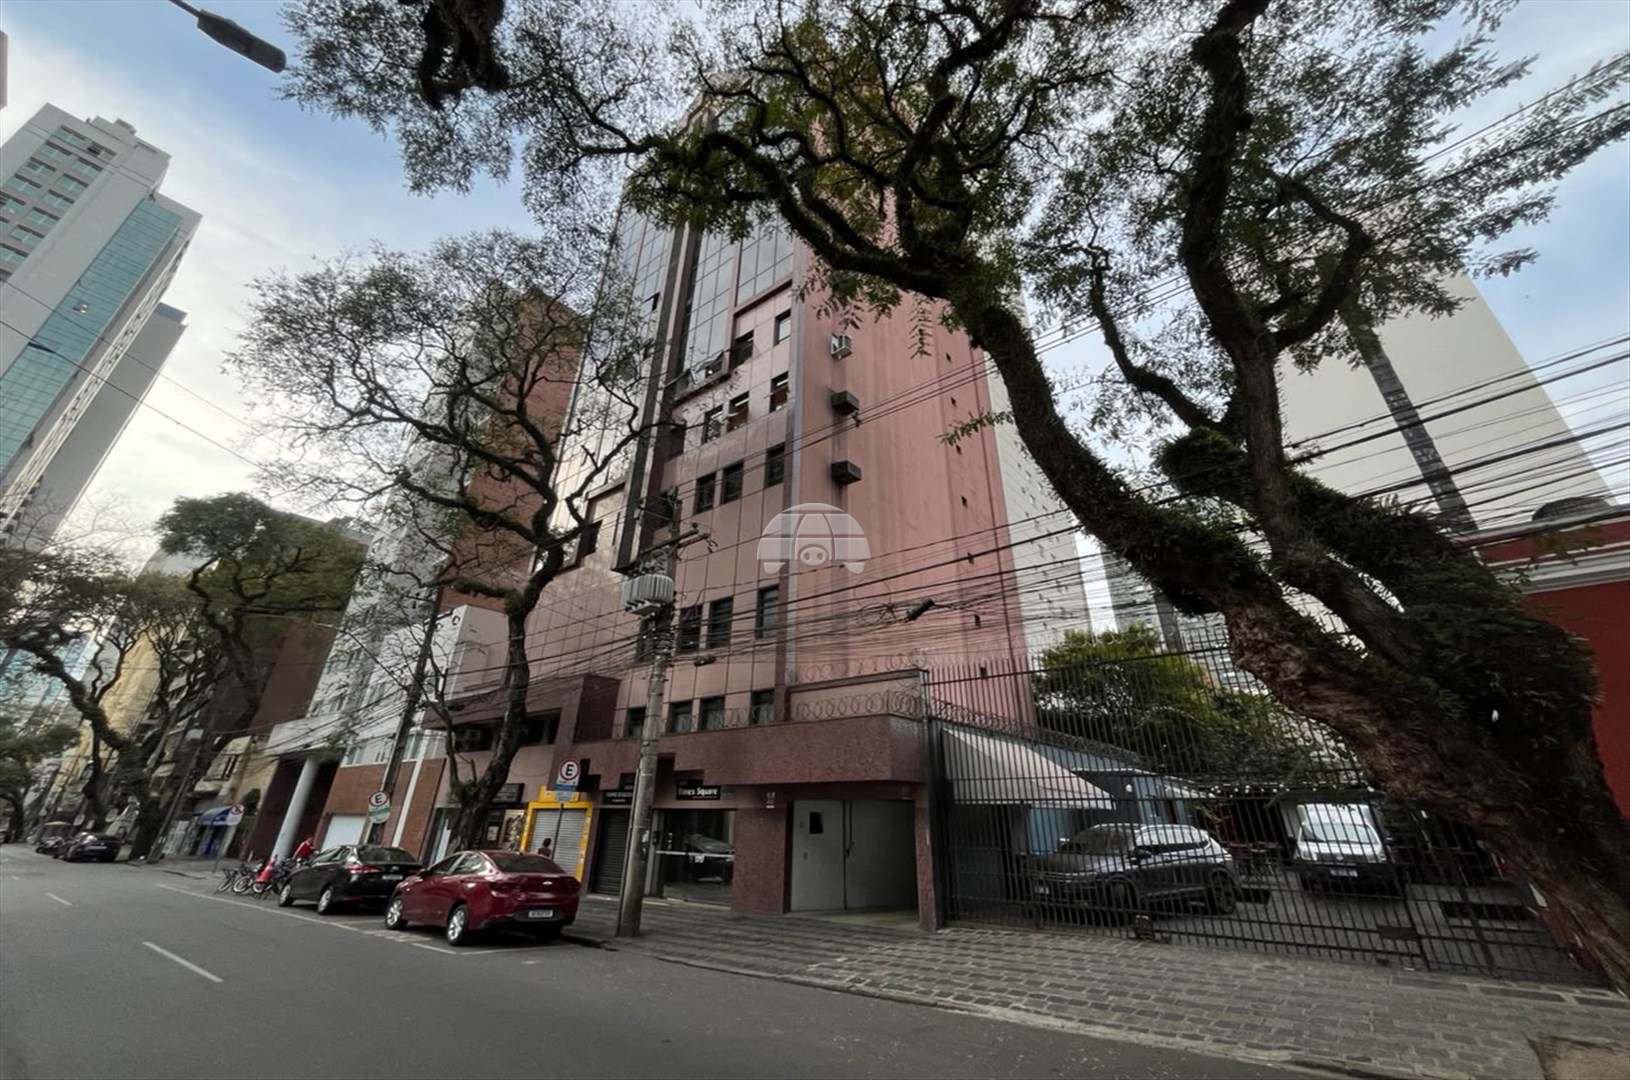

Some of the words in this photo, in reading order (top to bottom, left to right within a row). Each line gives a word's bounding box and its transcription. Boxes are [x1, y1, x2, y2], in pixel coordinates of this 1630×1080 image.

[566, 764, 574, 776] E
[697, 787, 718, 796] Square
[375, 793, 383, 804] E
